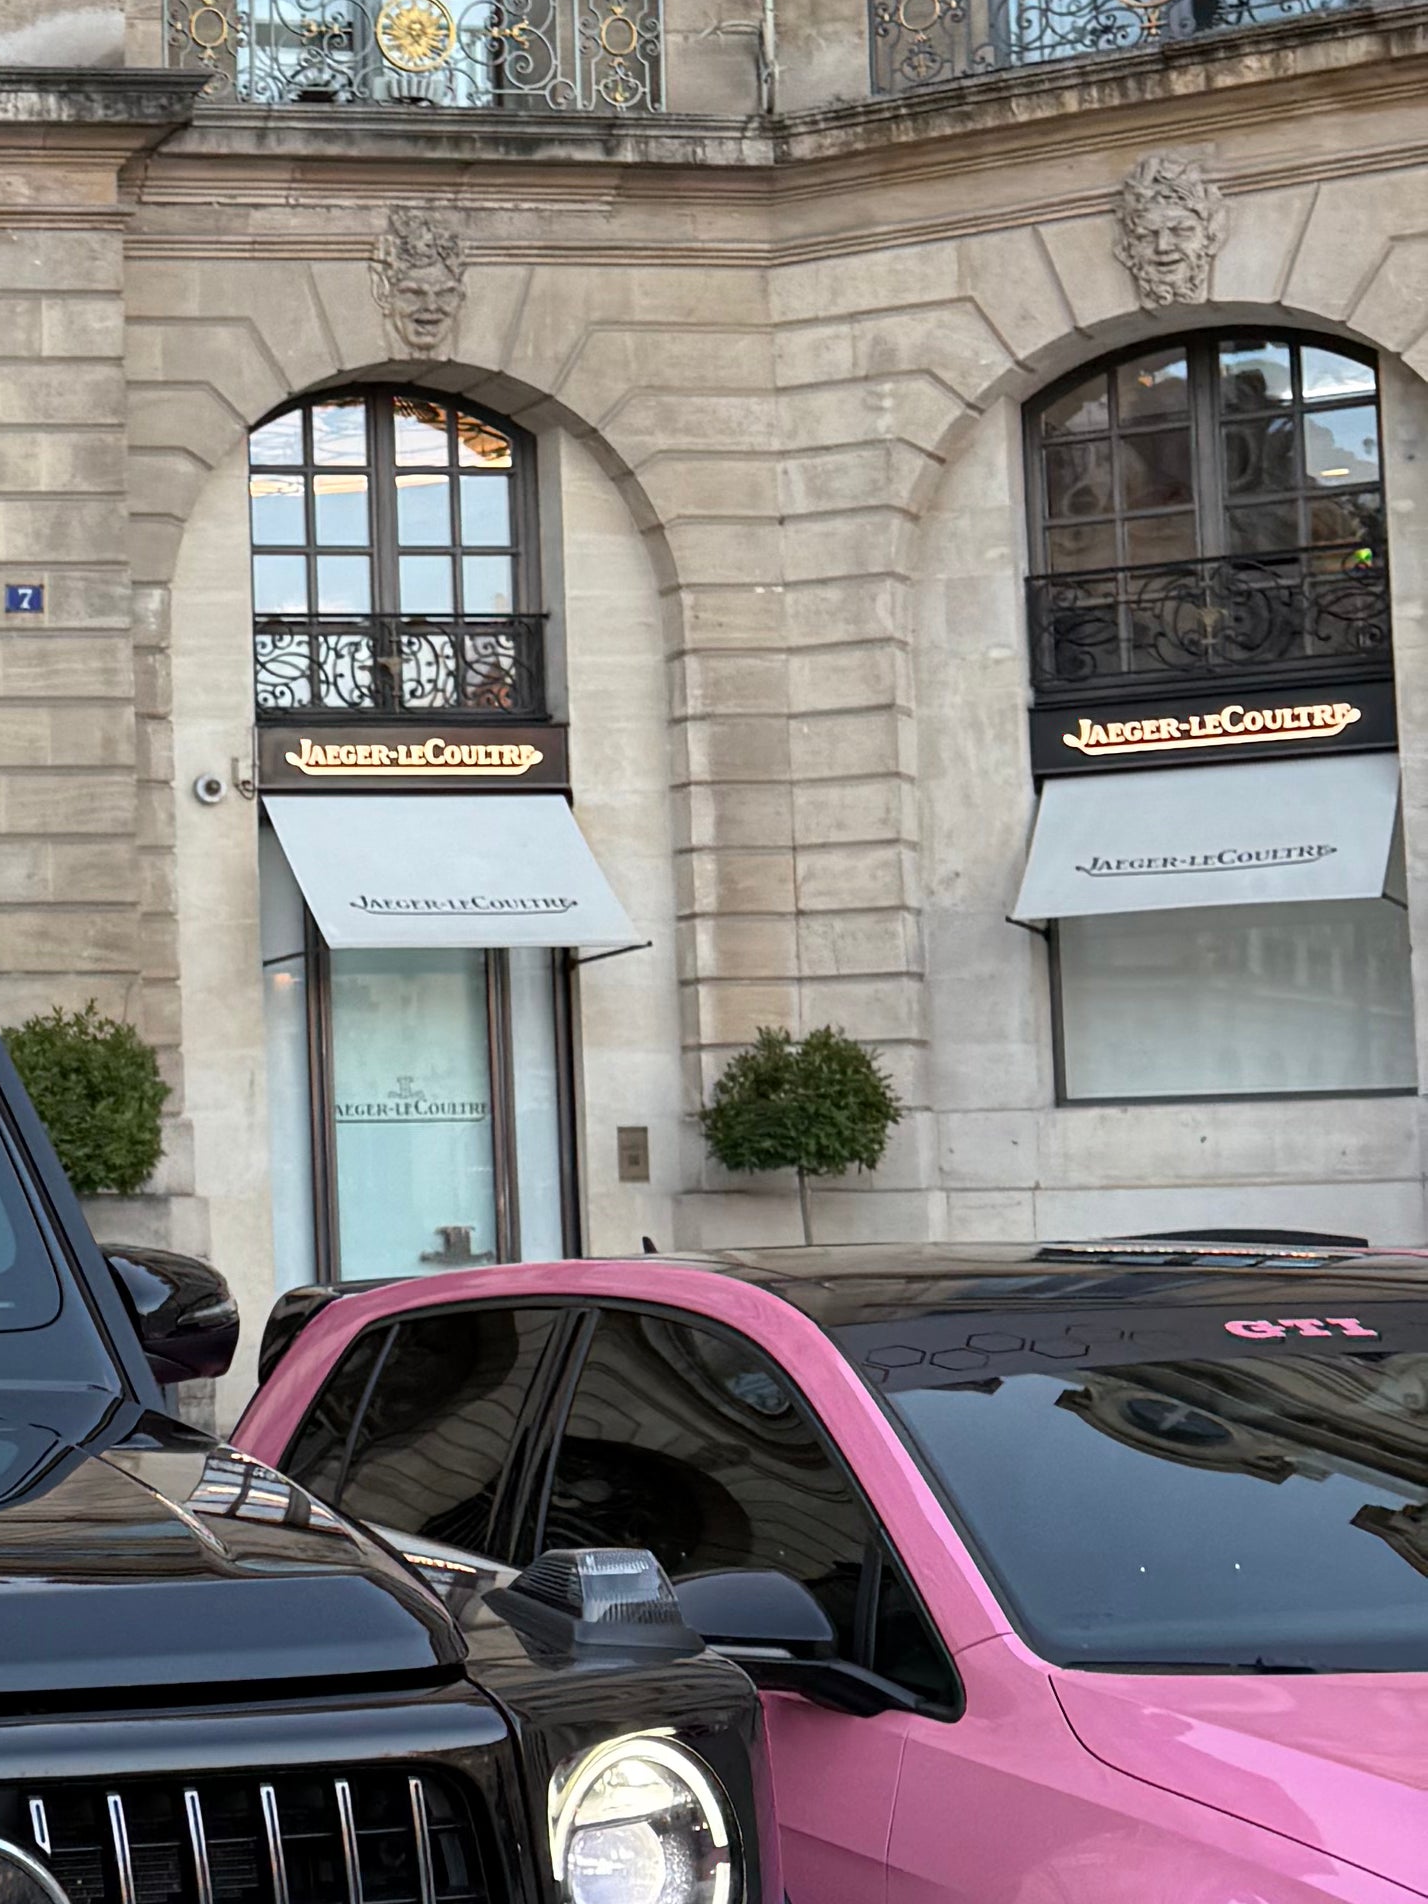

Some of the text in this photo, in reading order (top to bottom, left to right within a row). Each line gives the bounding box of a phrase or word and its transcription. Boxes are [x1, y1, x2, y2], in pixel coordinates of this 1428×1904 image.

[17, 588, 33, 610] 7
[335, 1099, 487, 1117] AEGER-LECOULTRE
[1224, 1318, 1378, 1339] GTI
